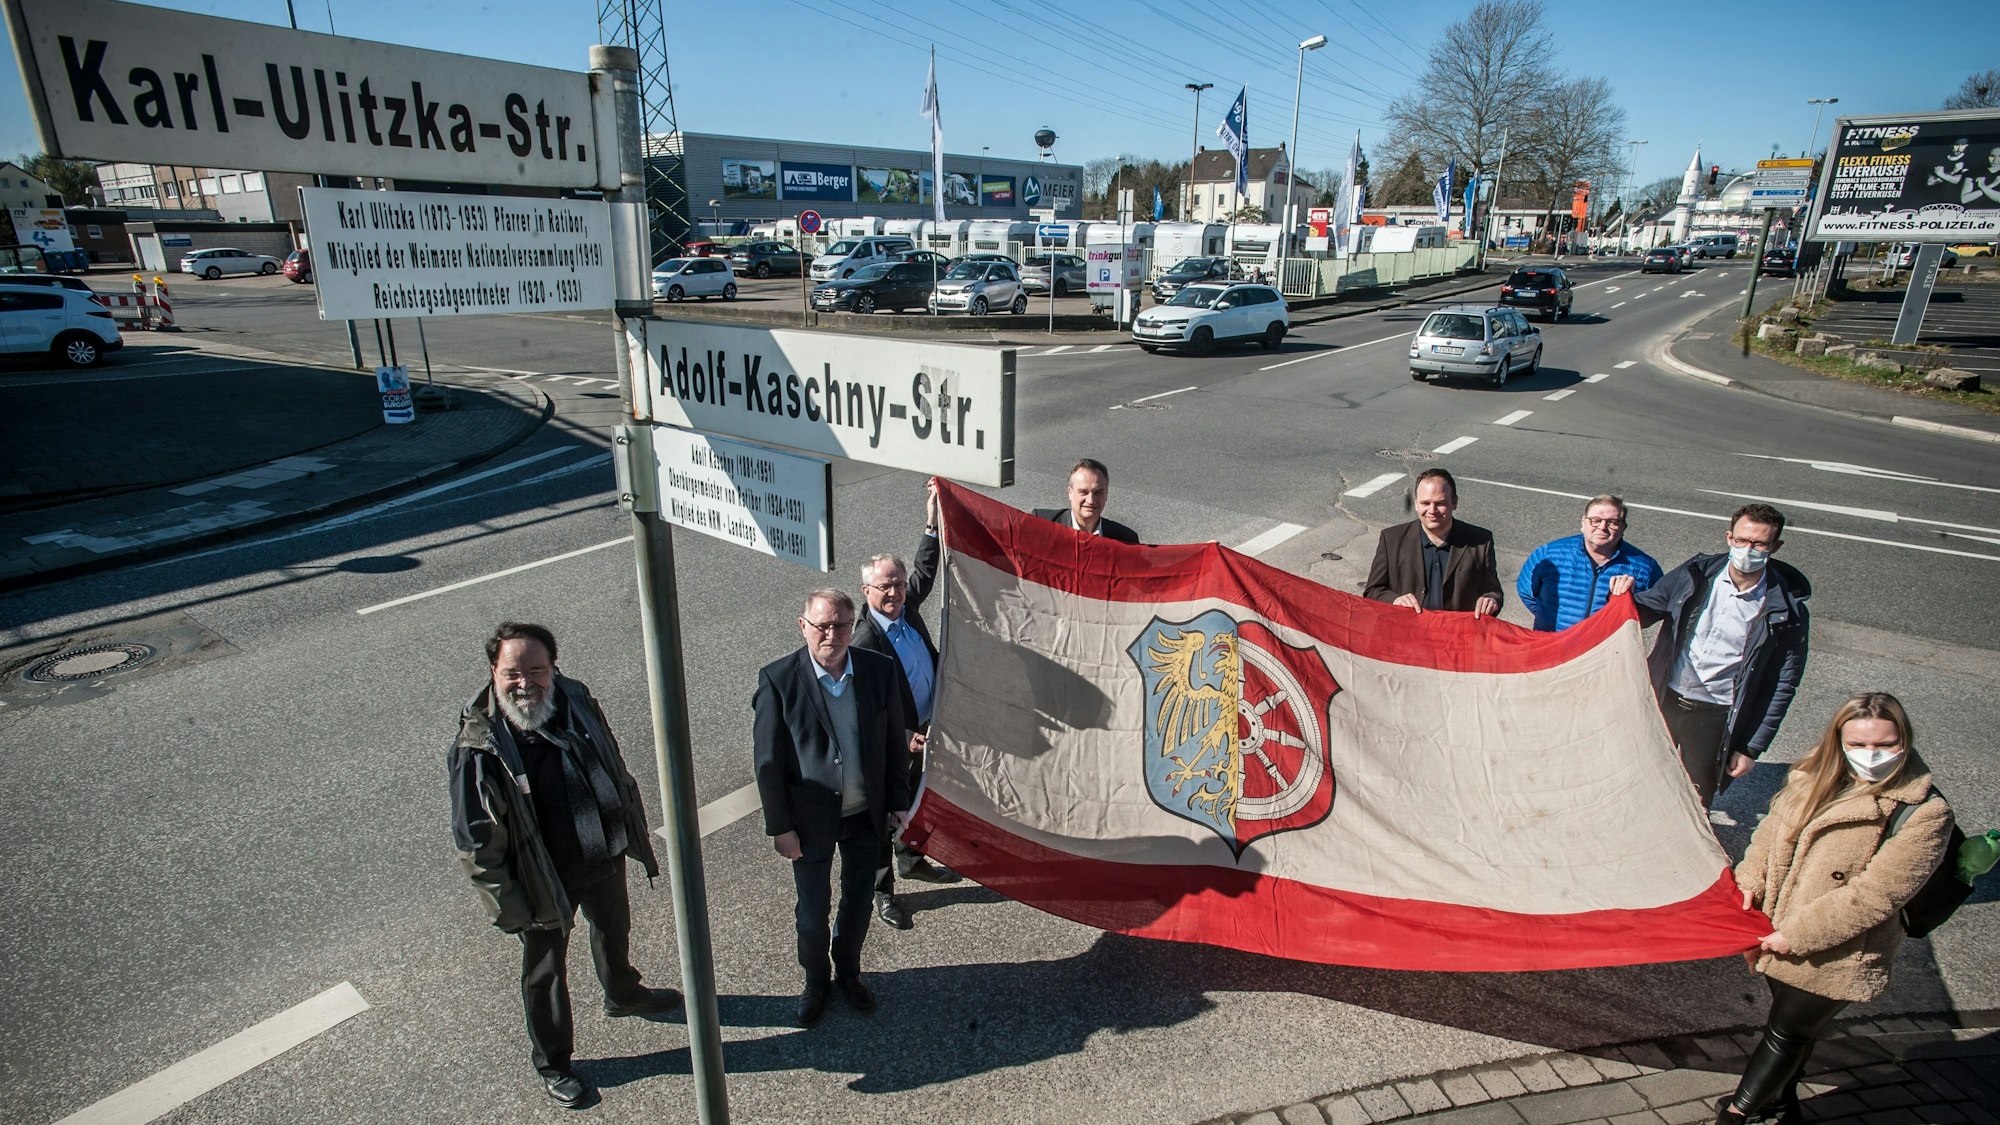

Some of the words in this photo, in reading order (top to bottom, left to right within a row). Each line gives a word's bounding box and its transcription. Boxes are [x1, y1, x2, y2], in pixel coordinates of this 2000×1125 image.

[57, 35, 586, 162] Karl-Ulitzka-Str.
[1845, 126, 1919, 140] FITNESS
[1839, 156, 1868, 166] FLEXX
[1870, 154, 1911, 165] FITNESS
[1836, 165, 1909, 177] LEVERKUSEN
[818, 172, 849, 190] Berger
[1832, 183, 1896, 191] OLOF-PALME-STR.
[1043, 183, 1074, 198] MEIER
[1830, 191, 1853, 199] 51371
[1855, 190, 1902, 198] LEVERKUSEN
[337, 200, 367, 229] Karl
[370, 201, 415, 231] Ulitzka
[420, 203, 489, 232] (1873-1953)
[494, 206, 531, 232] Pfarrer
[533, 208, 545, 233] in
[548, 207, 588, 238] Ratibor,
[1824, 221, 1995, 230] www.FITNESS-POLIZEI.de
[327, 241, 381, 276] Mitglied
[386, 242, 404, 269] der
[409, 242, 463, 268] Weimarer
[1088, 250, 1121, 262] trinkgut
[373, 282, 511, 314] Reichstagsabgeordneter
[659, 344, 985, 450] Adolf-Kaschny-Str.
[691, 443, 707, 467] Adolf
[709, 448, 734, 480] Kaschny
[736, 454, 775, 485] (1881-1951)
[669, 467, 723, 501] Oberbürgermeister
[725, 487, 736, 504] von
[737, 485, 762, 513] Ratibor
[764, 492, 806, 525] (1924-1933)
[671, 498, 694, 525] Mitglied
[696, 505, 707, 526] des
[708, 508, 722, 532] NRW
[727, 514, 757, 546] Landtags
[766, 525, 806, 558] (1950-1951)
